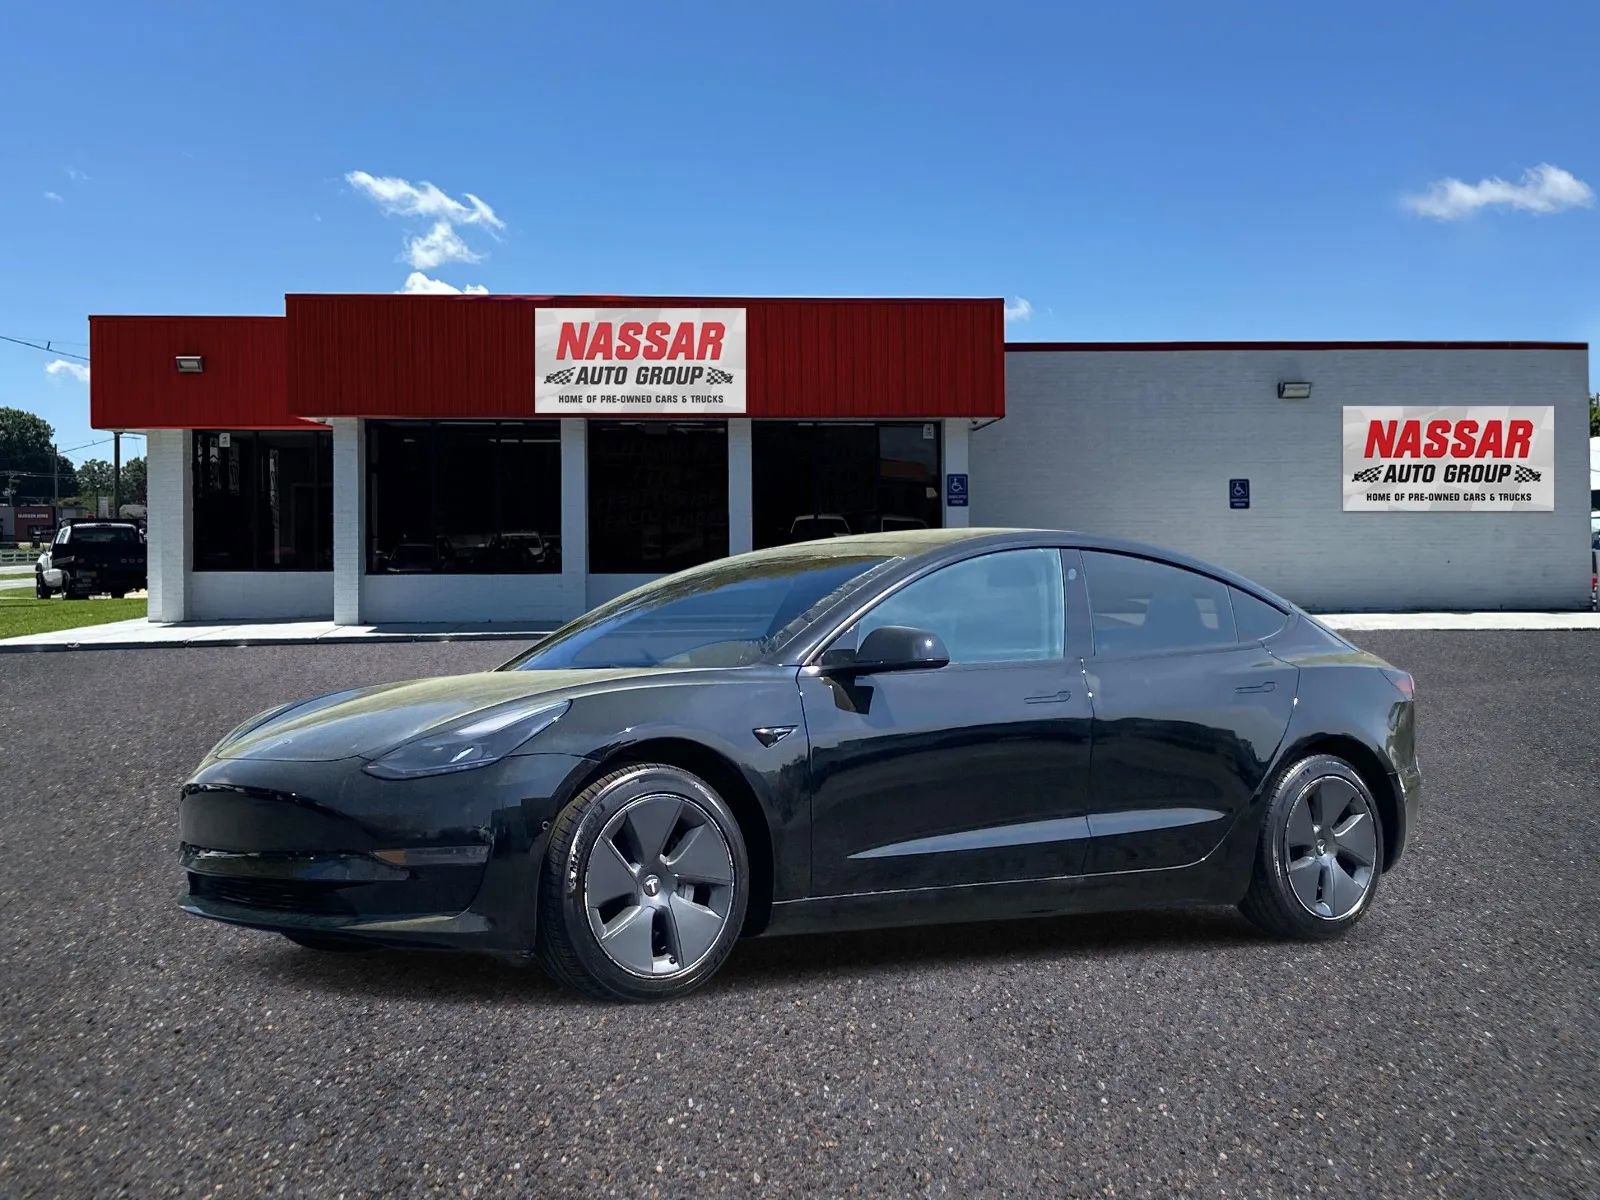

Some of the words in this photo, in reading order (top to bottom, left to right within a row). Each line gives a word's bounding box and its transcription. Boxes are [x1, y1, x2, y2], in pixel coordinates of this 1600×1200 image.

[556, 322, 726, 360] NASSAR
[575, 366, 628, 385] AUTO
[635, 366, 704, 385] GROUP
[559, 394, 583, 404] HOME
[587, 394, 597, 404] OF
[601, 394, 652, 404] PRE-OWNED
[656, 394, 678, 404] CARS
[681, 394, 688, 404] &
[691, 394, 724, 404] TRUCKS
[1364, 420, 1533, 458] NASSAR
[1383, 464, 1436, 483] AUTO
[1444, 464, 1512, 483] GROUP
[1367, 492, 1391, 502] HOME
[1395, 492, 1405, 502] OF
[1409, 492, 1460, 502] PRE-OWNED
[1464, 492, 1486, 502] CARS
[1490, 492, 1496, 502] &
[1499, 492, 1532, 502] TRUCKS
